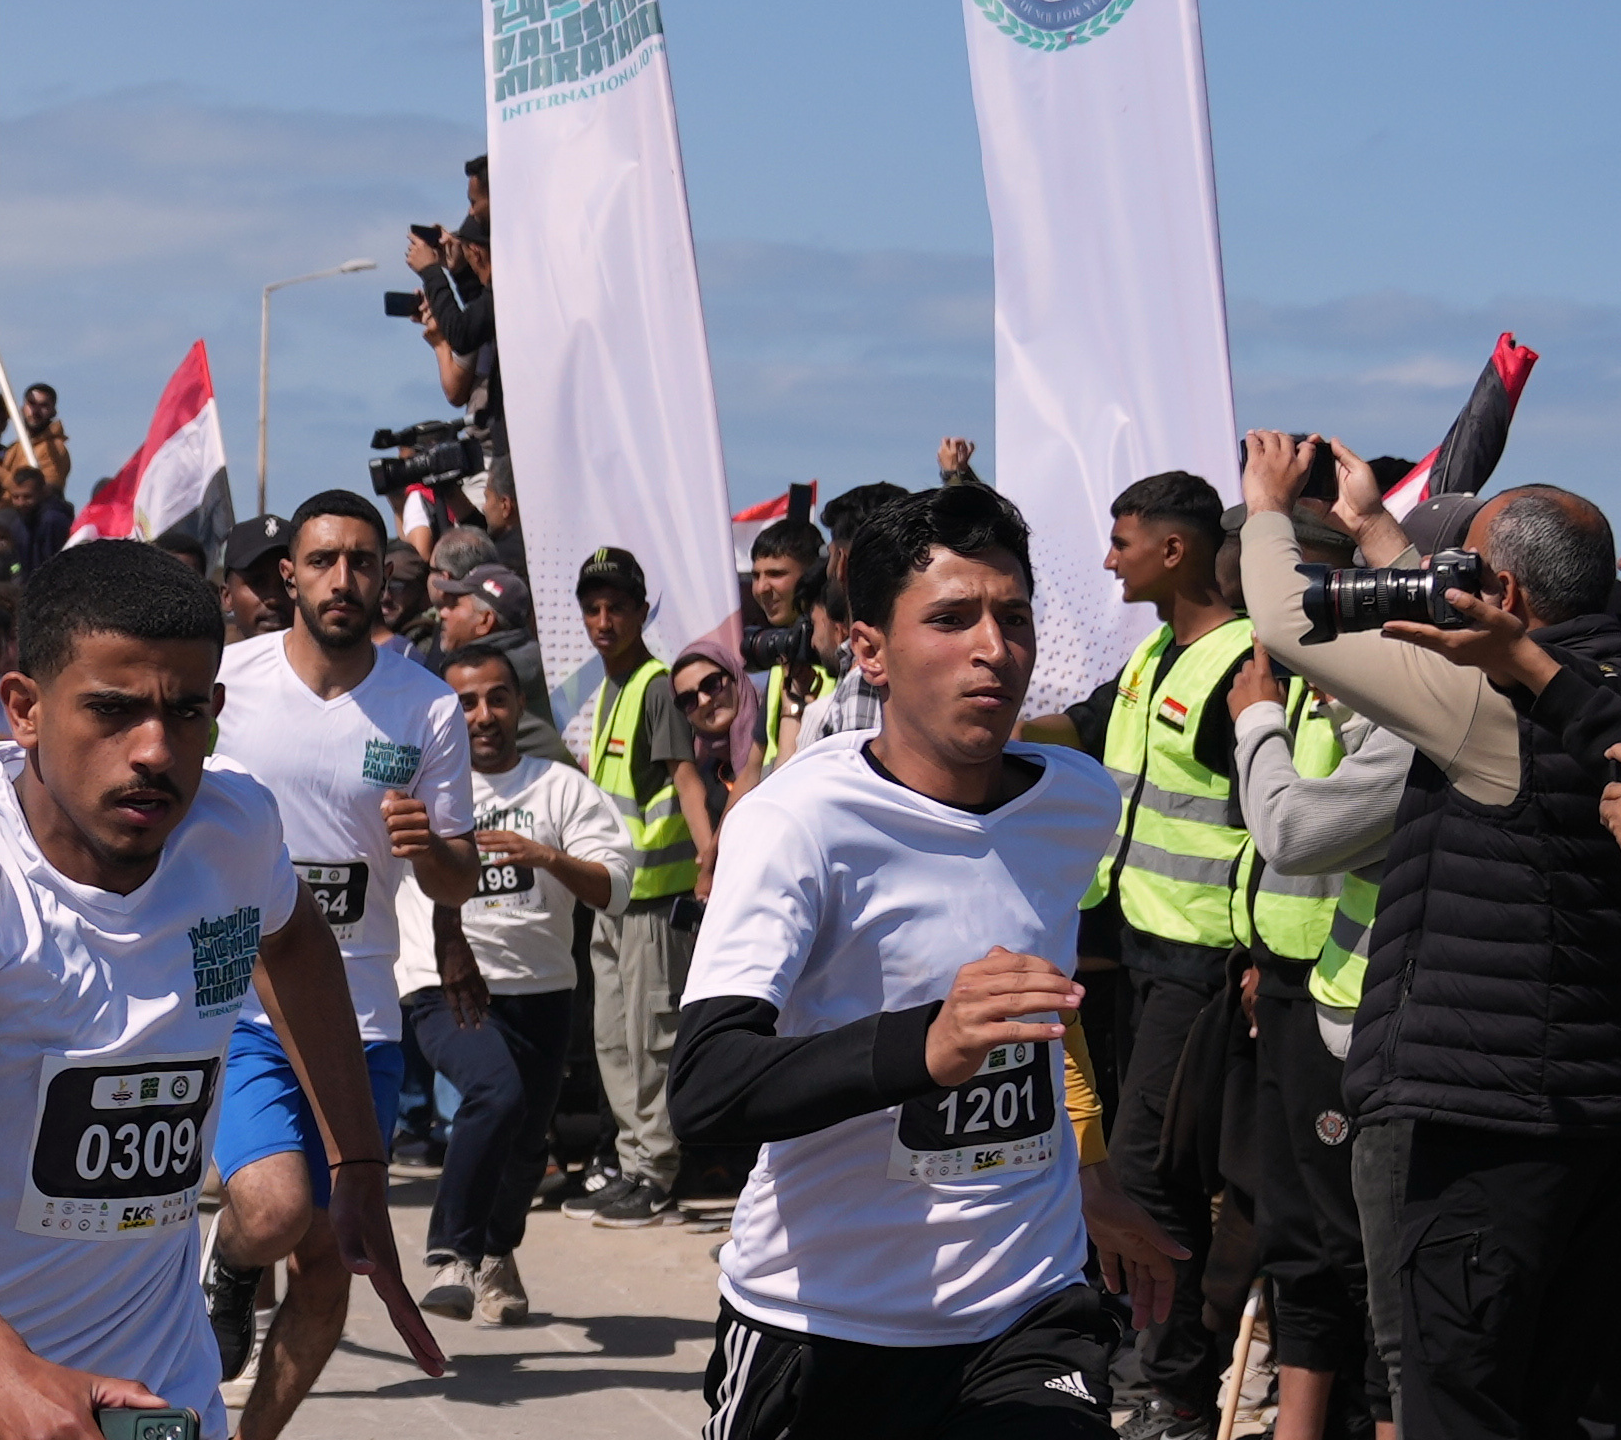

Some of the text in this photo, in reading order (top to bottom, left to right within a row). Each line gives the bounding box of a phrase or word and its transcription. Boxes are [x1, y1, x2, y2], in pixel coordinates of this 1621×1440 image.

[495, 0, 663, 103] MARATHON
[478, 865, 518, 892] 198
[314, 889, 348, 917] 64
[938, 1075, 1036, 1136] 1201
[76, 1118, 196, 1180] 0309
[1044, 1380, 1098, 1404] adidas
